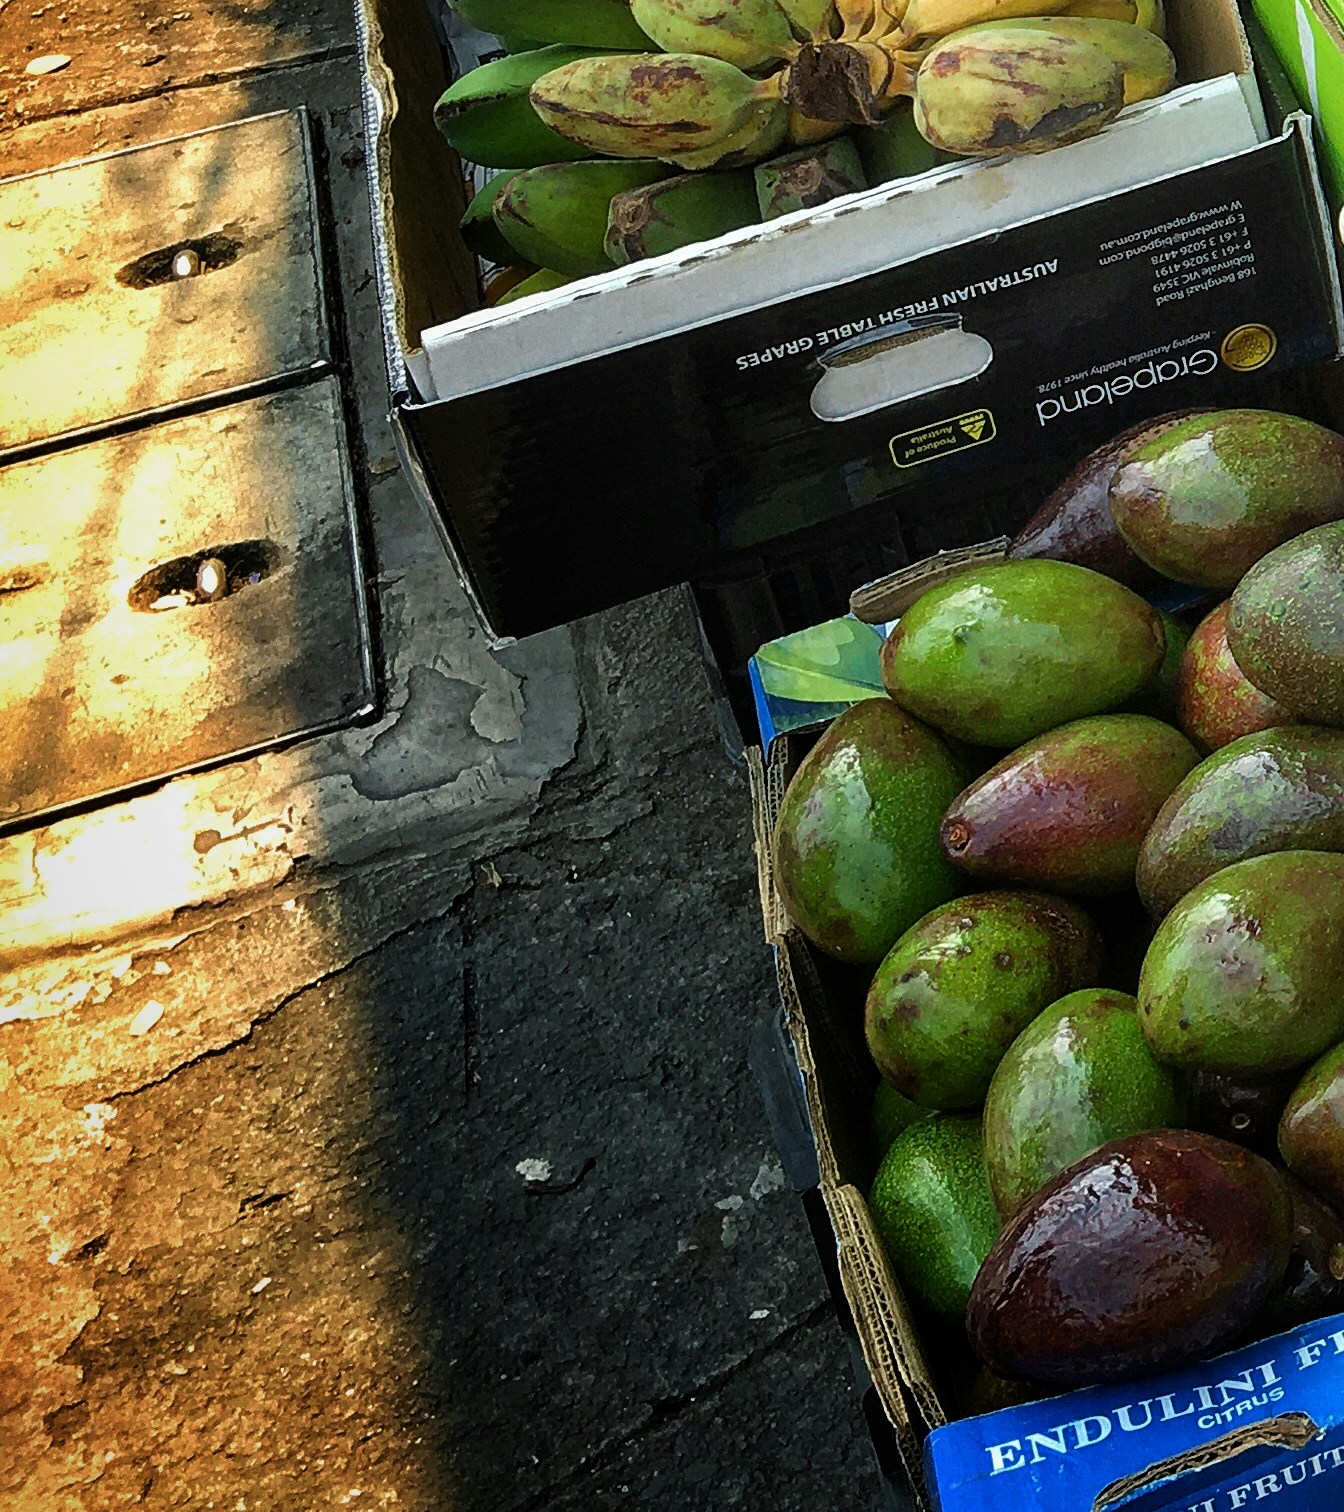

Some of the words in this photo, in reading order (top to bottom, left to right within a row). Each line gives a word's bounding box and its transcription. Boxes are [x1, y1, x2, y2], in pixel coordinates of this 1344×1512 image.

[1229, 200, 1243, 212] W
[1238, 212, 1246, 224] E
[1099, 203, 1229, 252] www.grapeland.com.au
[1218, 229, 1238, 243] +61
[1241, 225, 1249, 237] F
[1099, 214, 1238, 267] grapeland@bigpond.com
[1179, 239, 1208, 256] 5026
[1208, 236, 1217, 247] 3
[1221, 243, 1242, 256] +61
[1244, 239, 1252, 250] P
[1150, 247, 1179, 266] 4478
[1182, 252, 1210, 269] 5026
[1211, 249, 1219, 260] 3
[1154, 261, 1182, 278] 4191
[1201, 252, 1255, 276] Robinvale
[1181, 270, 1200, 284] VIC
[1235, 266, 1257, 281] 168
[943, 258, 1059, 308] AUSTRALIAN
[1152, 276, 1180, 294] 3549
[1185, 272, 1235, 299] Benghazi
[1155, 289, 1185, 307] Road
[878, 295, 941, 325] FRESH
[817, 312, 877, 339] TABLE
[735, 337, 814, 371] GRAPES
[1129, 343, 1172, 364] Australia
[1064, 367, 1090, 384] since
[1090, 357, 1128, 377] healthy
[1035, 349, 1219, 427] Grapeland
[910, 425, 953, 444] Australia
[904, 445, 916, 460] of
[917, 435, 957, 454] Produce
[1197, 1386, 1285, 1431] CITRUS
[985, 1359, 1283, 1477] ENDULINI
